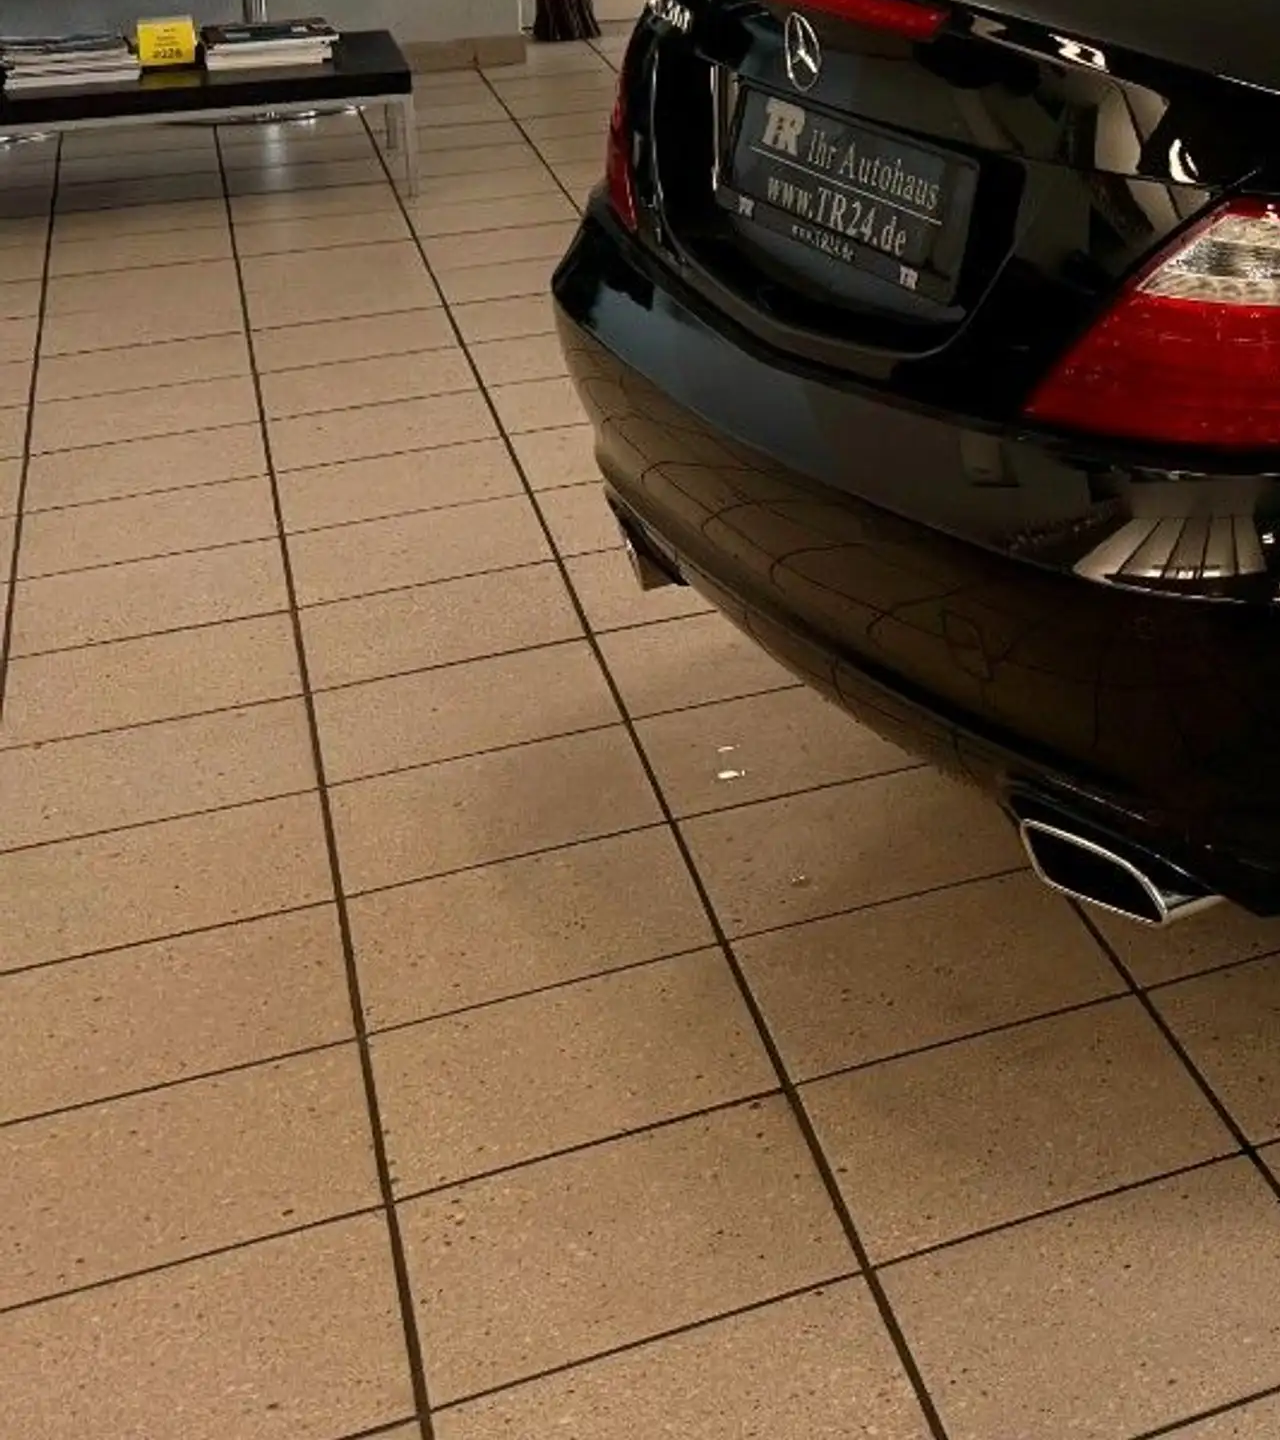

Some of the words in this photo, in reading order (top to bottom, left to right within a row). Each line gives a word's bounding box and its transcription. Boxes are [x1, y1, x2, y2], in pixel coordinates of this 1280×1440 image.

[807, 129, 837, 169] Ihr
[838, 141, 940, 210] Autohaus
[767, 176, 907, 255] www.TR24.de
